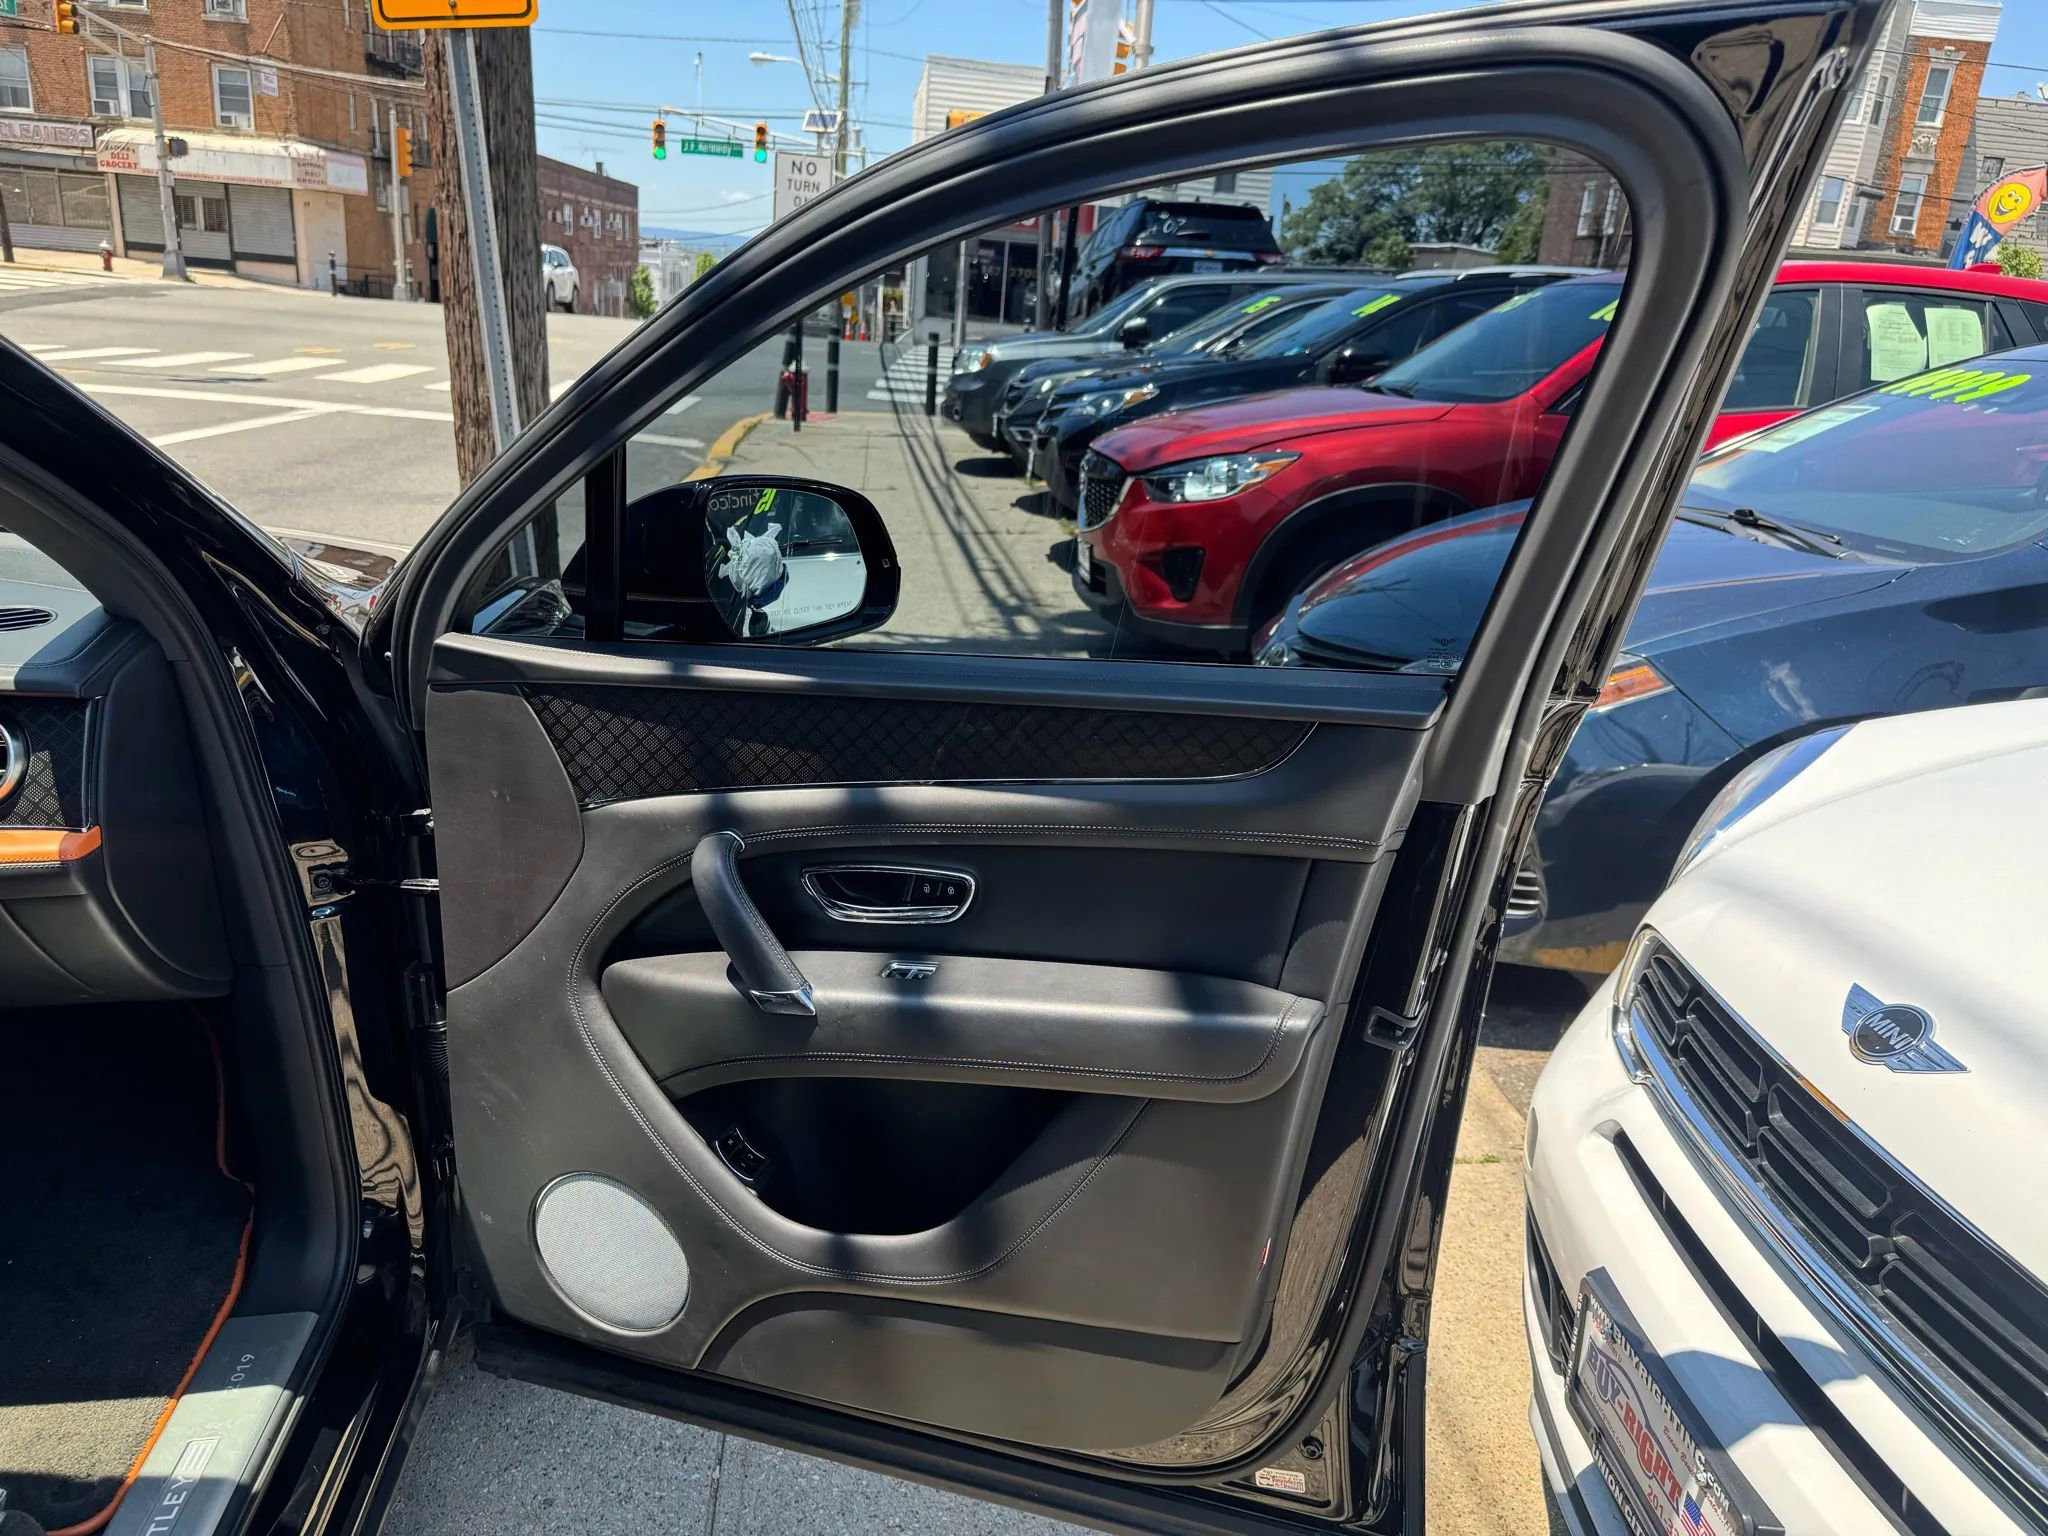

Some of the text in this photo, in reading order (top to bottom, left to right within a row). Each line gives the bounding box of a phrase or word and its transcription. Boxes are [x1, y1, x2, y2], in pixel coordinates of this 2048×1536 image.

[110, 152, 129, 161] DELI
[99, 160, 138, 170] GROCERY
[791, 160, 817, 176] NO
[787, 178, 820, 193] TURN
[1864, 1013, 1914, 1050] MINI
